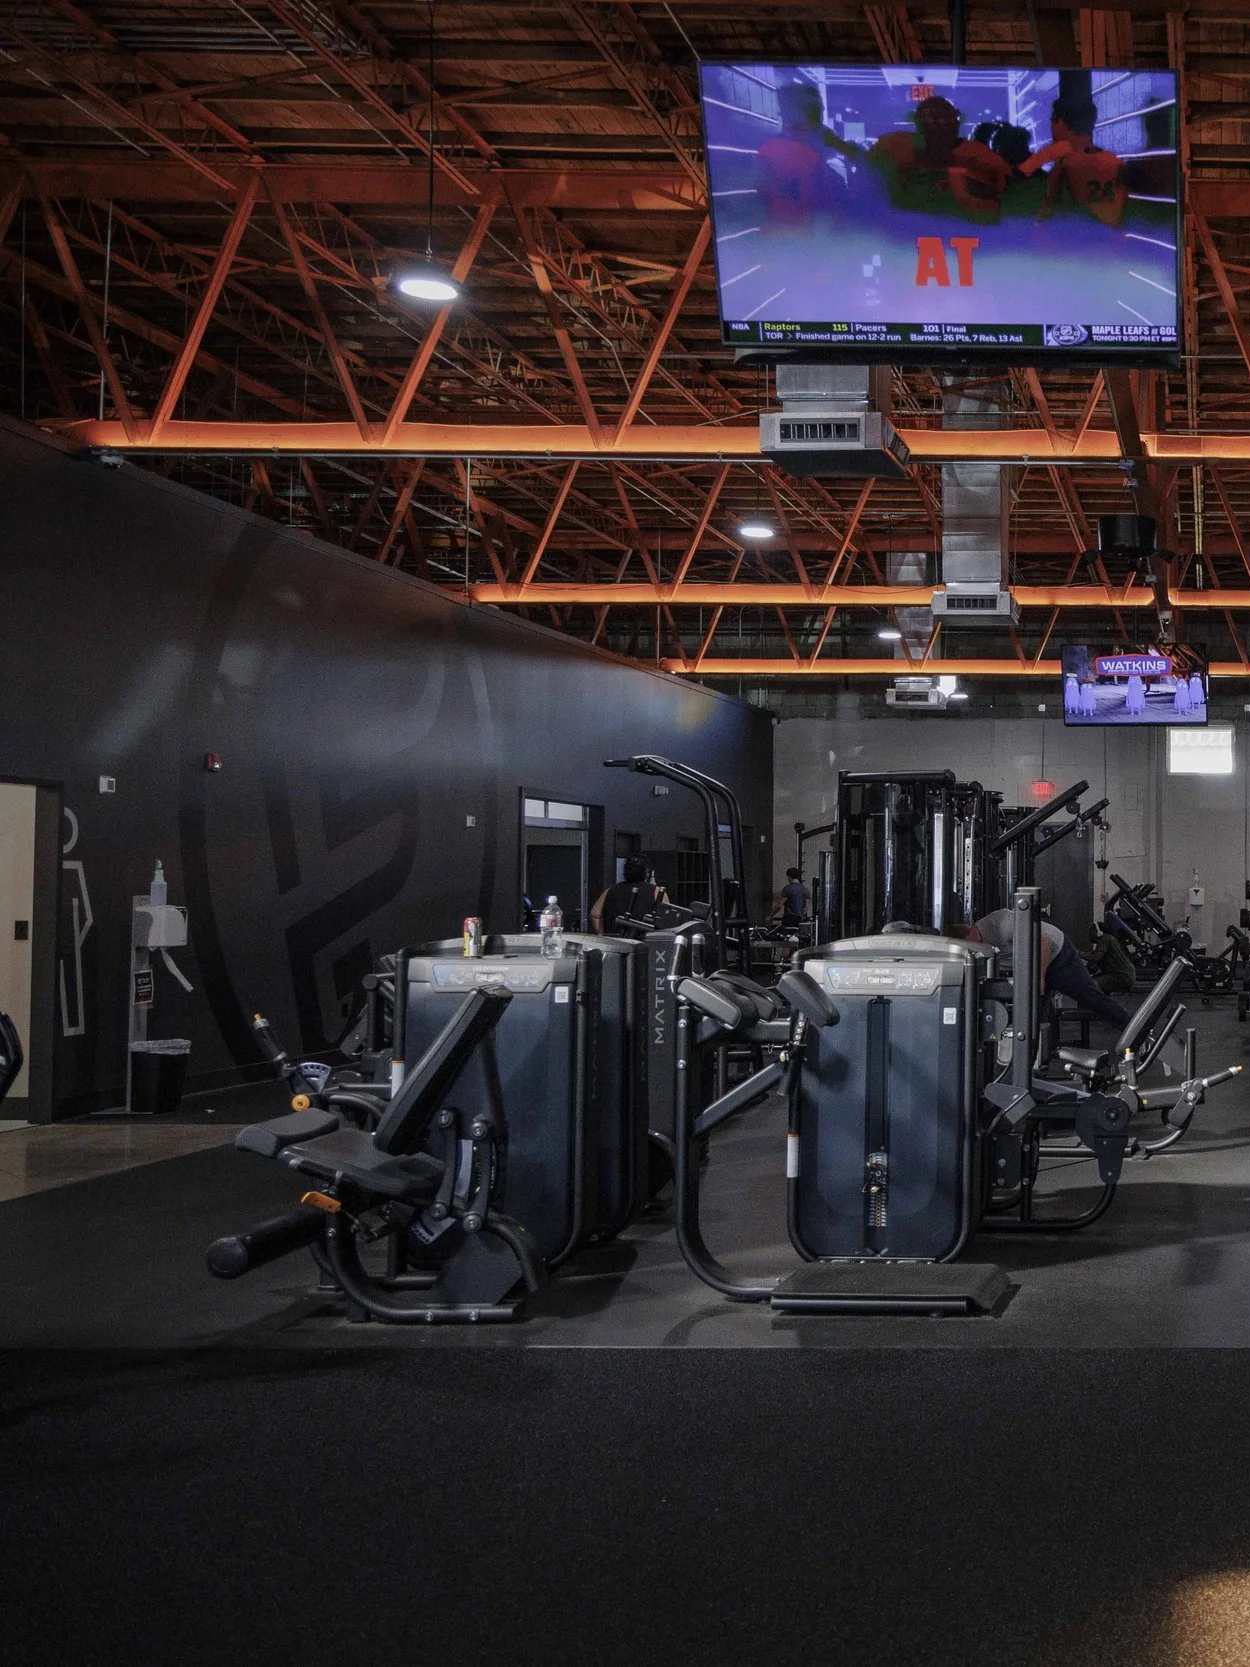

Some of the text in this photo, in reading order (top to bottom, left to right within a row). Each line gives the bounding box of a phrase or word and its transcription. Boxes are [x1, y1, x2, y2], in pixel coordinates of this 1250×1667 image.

[915, 236, 979, 287] AT
[732, 323, 750, 331] NBA
[764, 322, 848, 332] Raptors 115
[855, 324, 940, 333] Pacers 101
[946, 325, 967, 333] Final
[1092, 325, 1120, 335] MAPLE
[1123, 325, 1149, 335] LEAFS
[1160, 326, 1177, 335] GOL
[796, 332, 831, 340] Finished
[910, 333, 942, 341] Barnes:
[1101, 660, 1166, 671] WATKINS
[654, 950, 665, 1044] MATRIX
